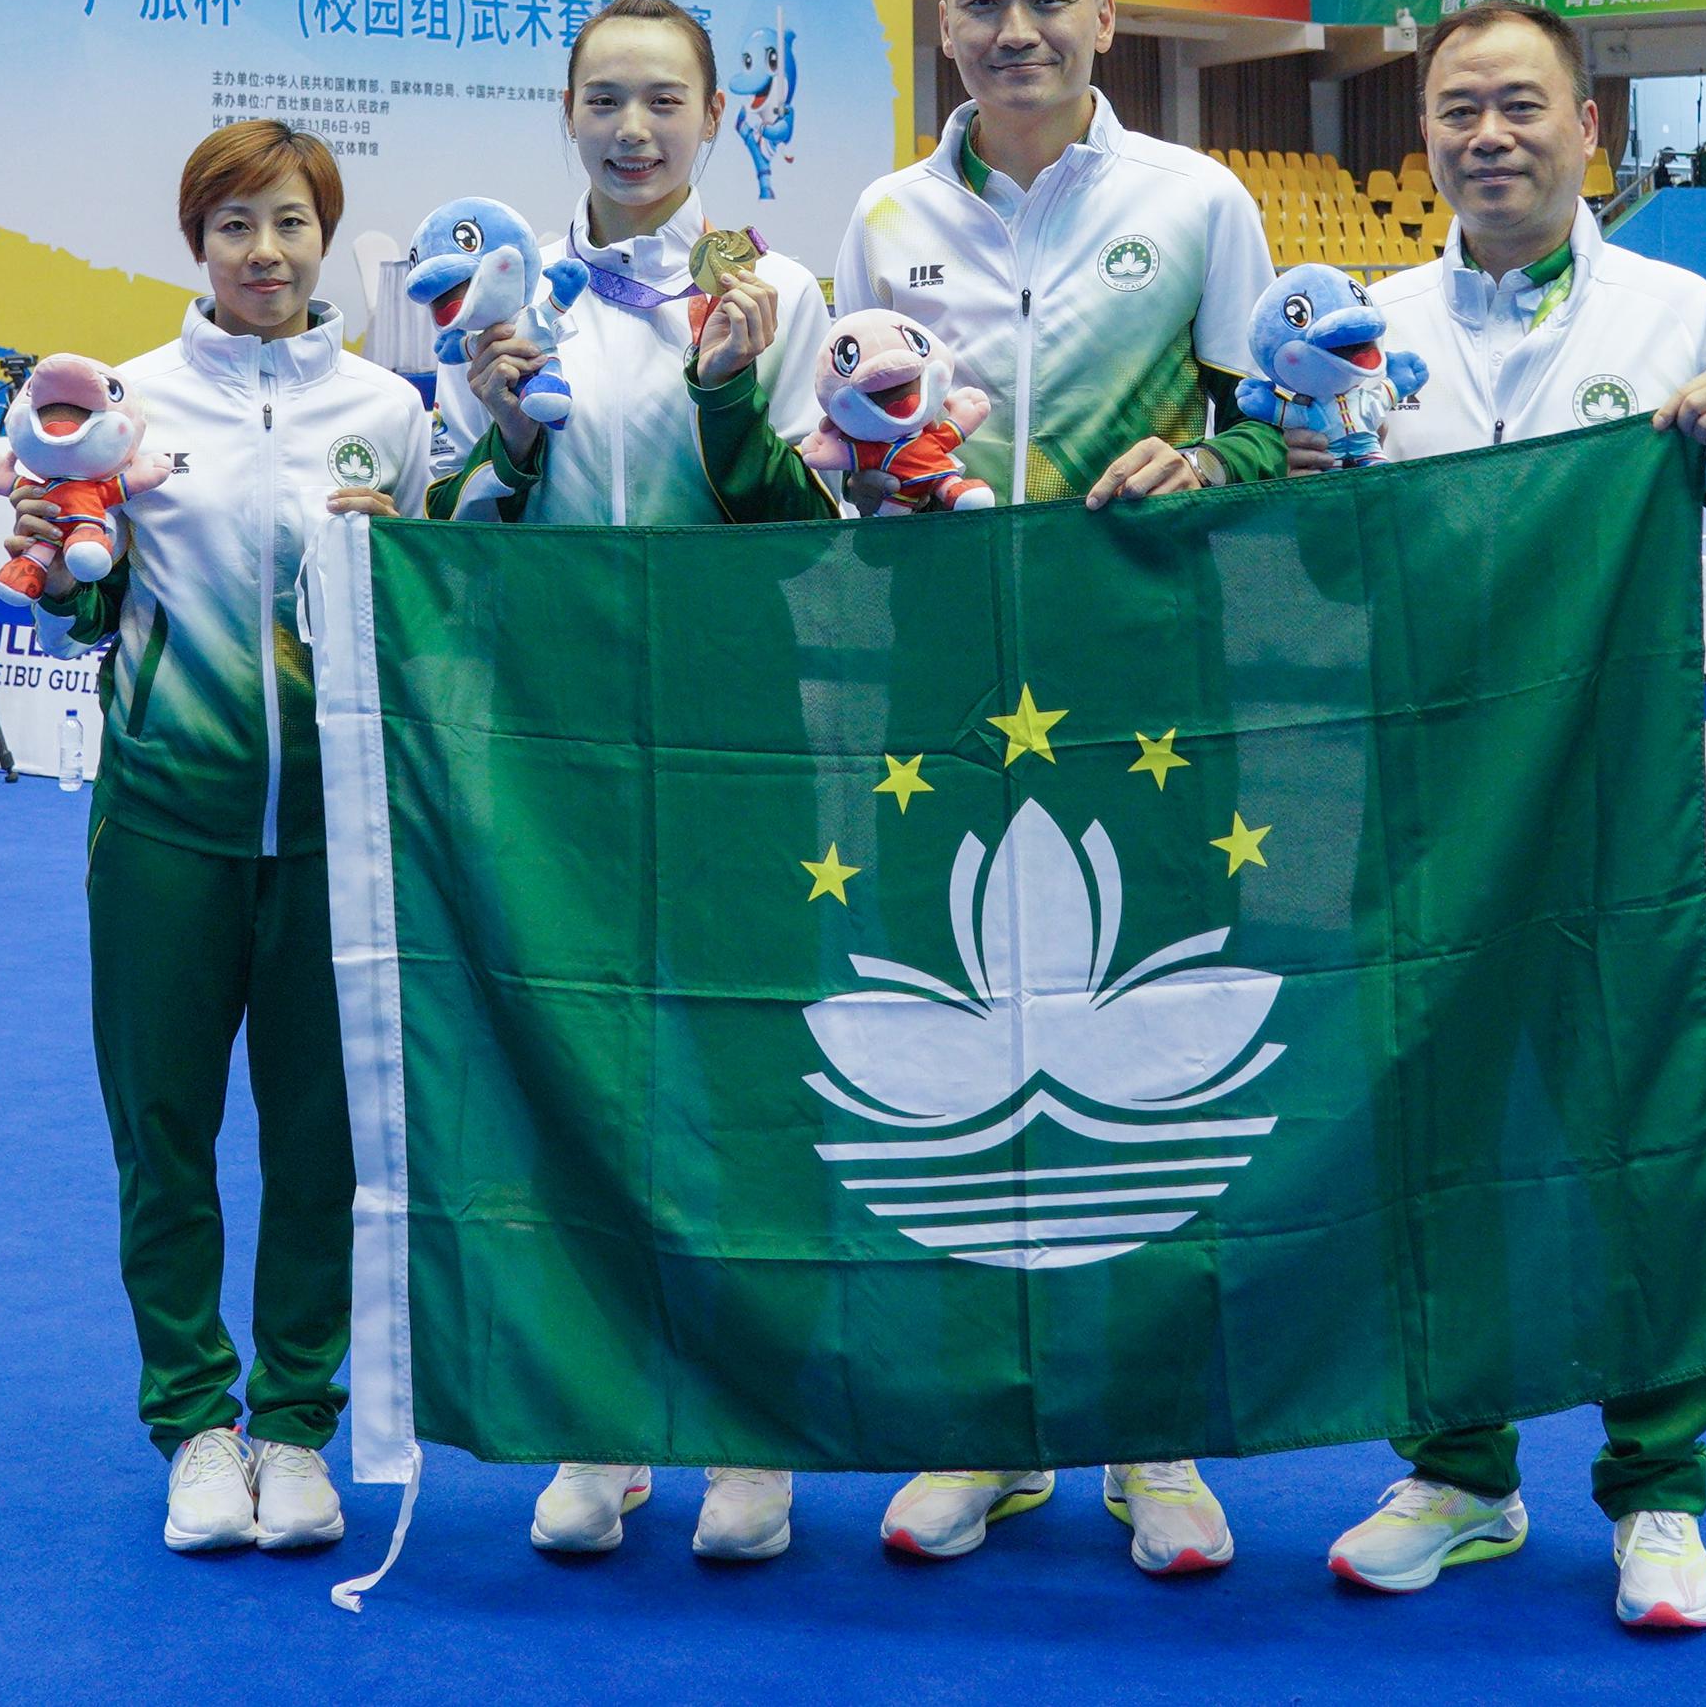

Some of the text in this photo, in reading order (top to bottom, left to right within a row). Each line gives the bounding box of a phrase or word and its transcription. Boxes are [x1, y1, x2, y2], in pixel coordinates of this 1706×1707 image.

[212, 71, 566, 102] 主办单位:中华人民共和国教育部、国家体育总局、中国共产主义青年团中
[48, 669, 101, 695] GUL
